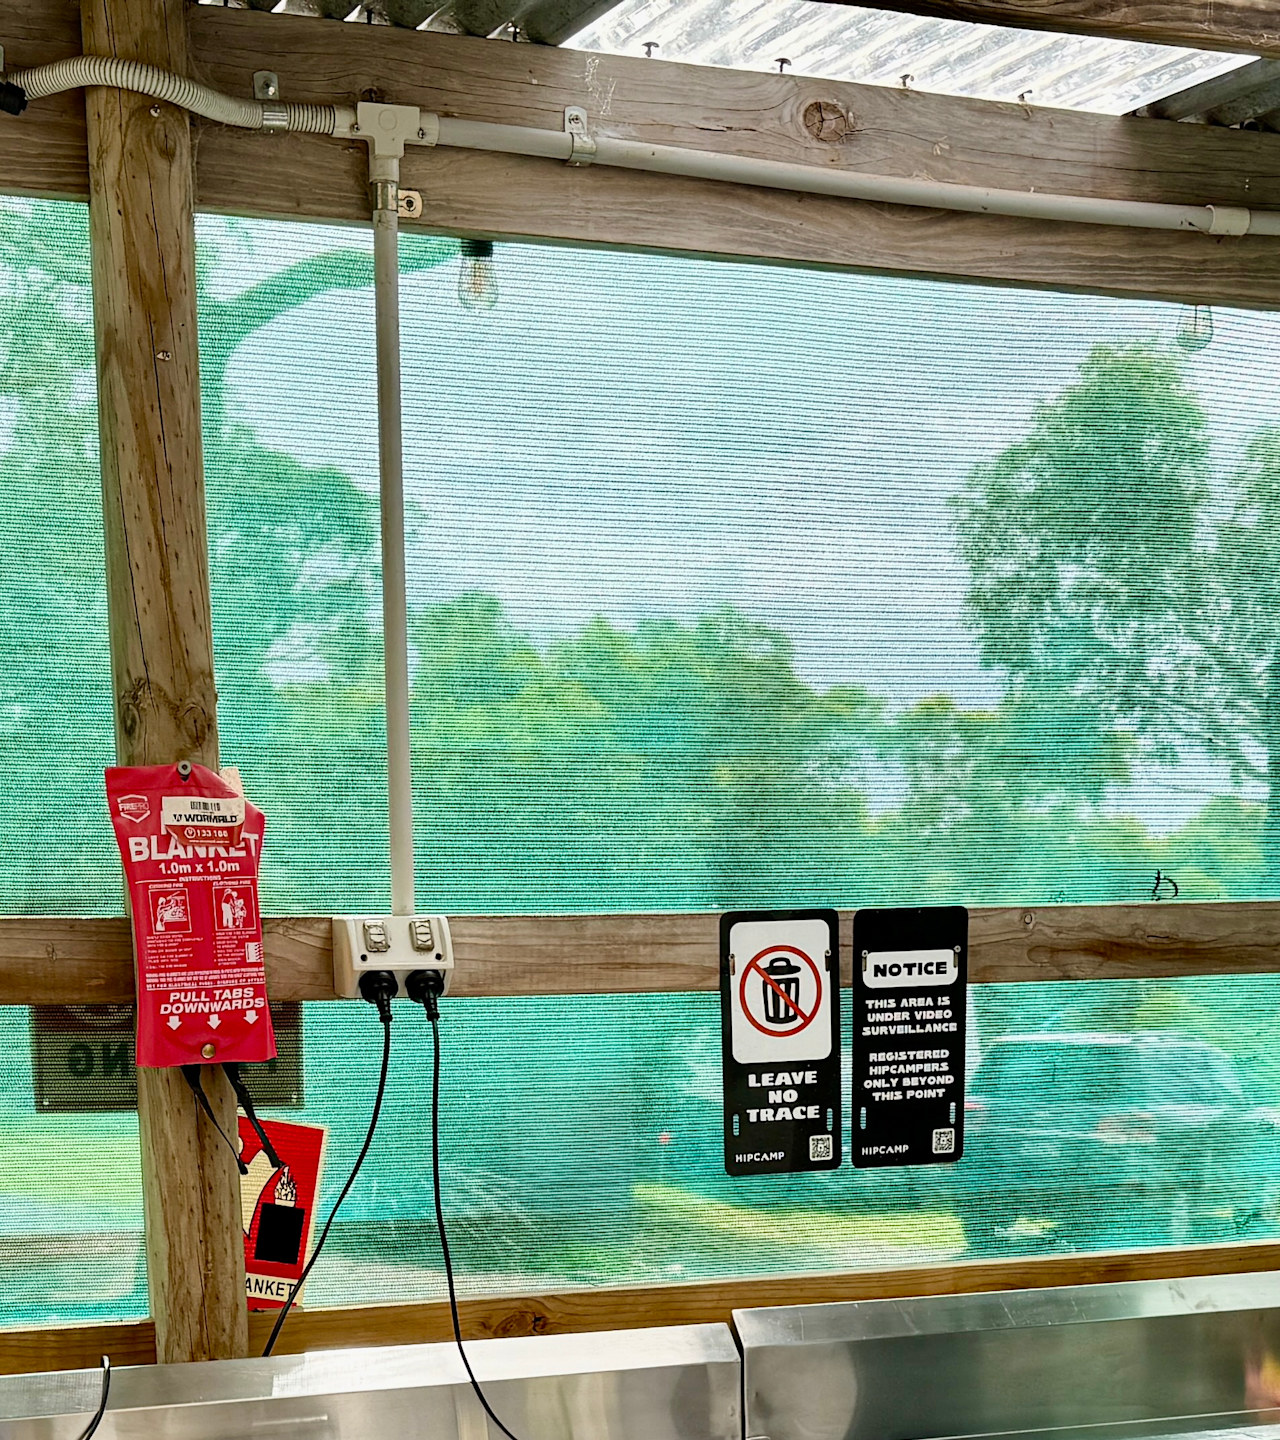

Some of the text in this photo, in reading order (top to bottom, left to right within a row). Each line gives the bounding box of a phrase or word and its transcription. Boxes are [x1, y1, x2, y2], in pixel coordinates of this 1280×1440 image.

[185, 814, 237, 823] WORMALD
[159, 860, 240, 874] 1.0m x 1.0m
[874, 961, 948, 978] NOTICE
[170, 987, 254, 1003] PULL TABS
[160, 998, 265, 1015] DOWNWARDS
[866, 996, 950, 1010] THIS AREA IS
[867, 1010, 952, 1022] UNDER VIDEO
[862, 1022, 958, 1036] SURVEILLANCE
[869, 1050, 950, 1062] REGISTERED
[869, 1062, 950, 1075] HIPCAMPERS
[748, 1070, 818, 1088] LEAVE
[864, 1074, 955, 1089] ONLY BEYOND
[768, 1090, 798, 1104] NO
[872, 1088, 946, 1102] THIS POINT
[747, 1106, 820, 1123] TRACE
[862, 1144, 909, 1155] HIPCAMP
[735, 1152, 785, 1163] HIPCAMP
